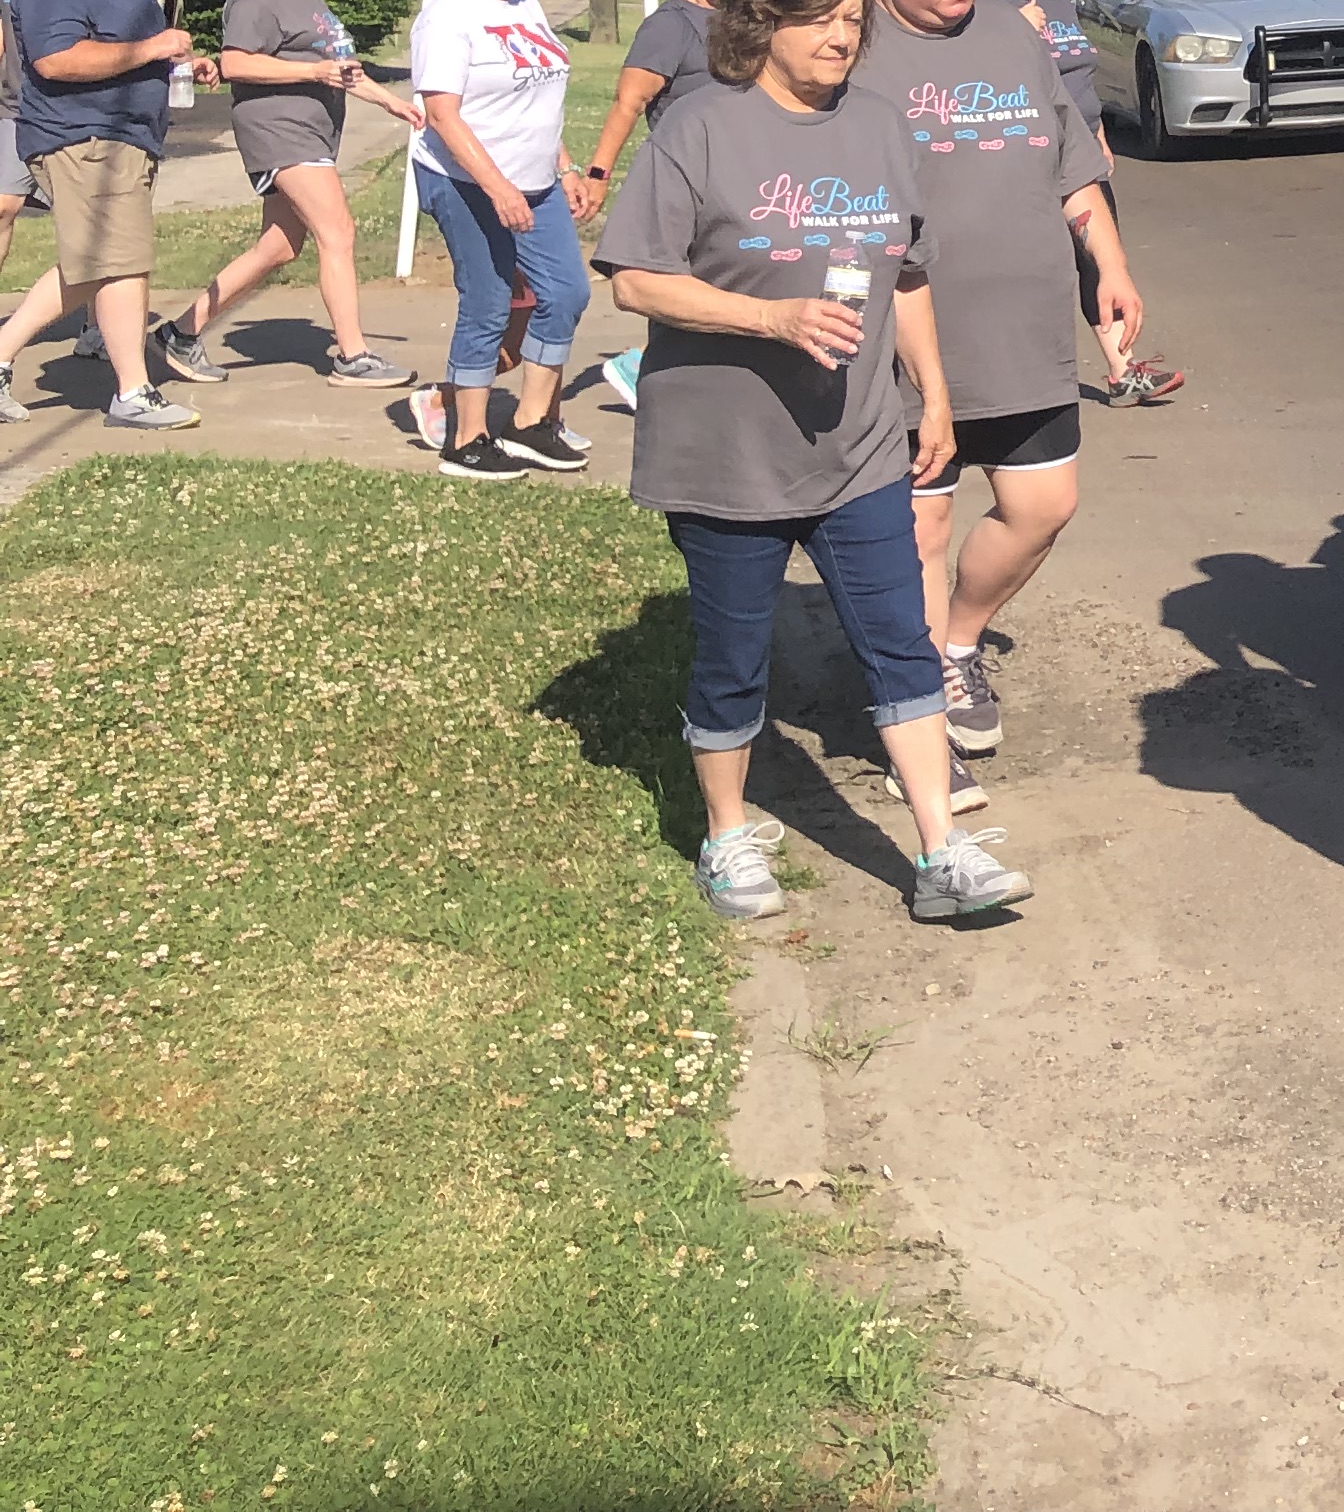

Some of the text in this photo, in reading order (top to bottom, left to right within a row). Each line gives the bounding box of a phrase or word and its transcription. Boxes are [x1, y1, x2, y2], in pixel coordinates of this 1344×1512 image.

[950, 108, 1040, 124] WALK FOR LIFE
[801, 213, 900, 227] WALK FOR LIFE
